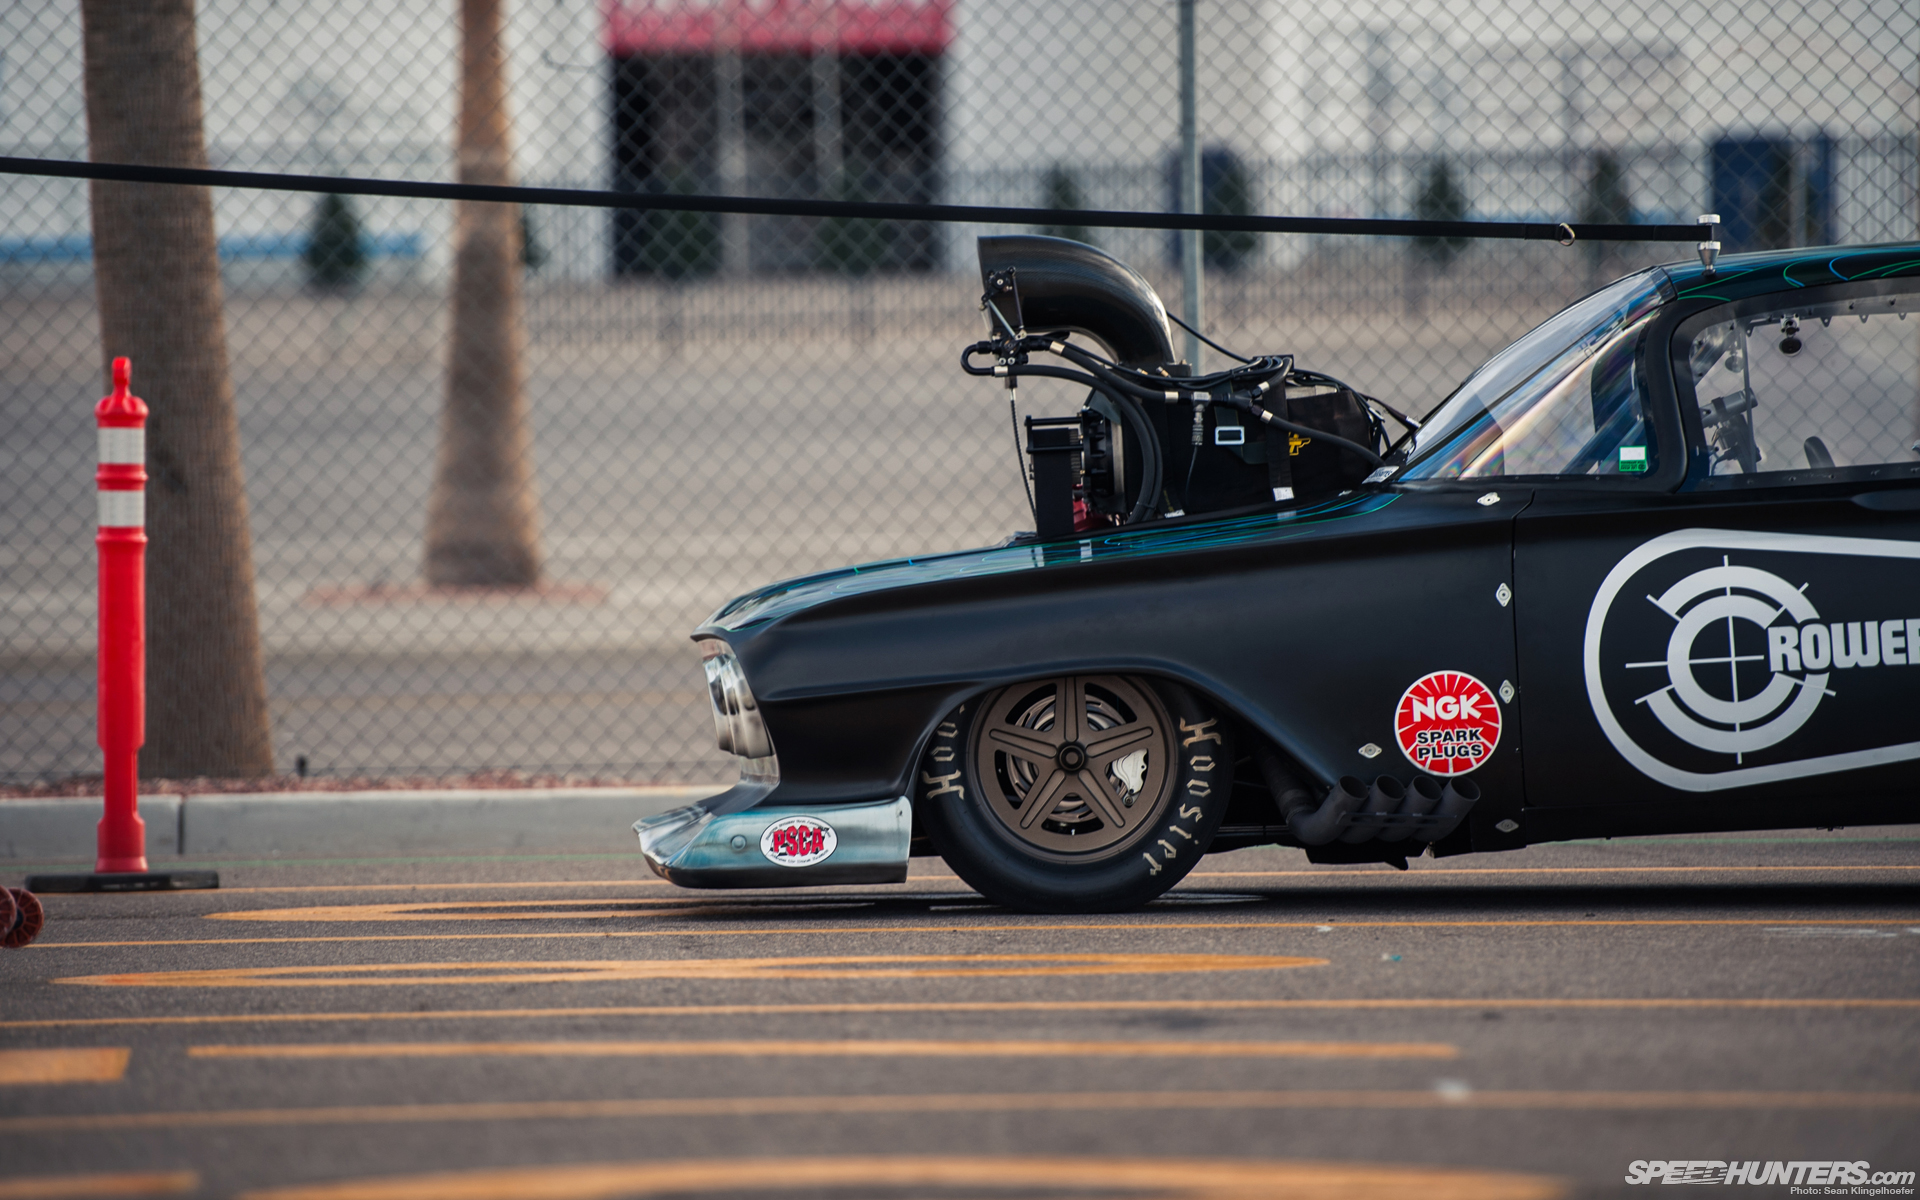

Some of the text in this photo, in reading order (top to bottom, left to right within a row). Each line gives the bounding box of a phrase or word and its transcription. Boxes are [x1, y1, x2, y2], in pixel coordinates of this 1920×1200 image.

[1412, 693, 1482, 722] NGK
[1416, 727, 1483, 745] SPARK
[1416, 744, 1483, 760] PLUGS
[1143, 717, 1221, 875] Hoosier
[773, 825, 824, 857] PSCA
